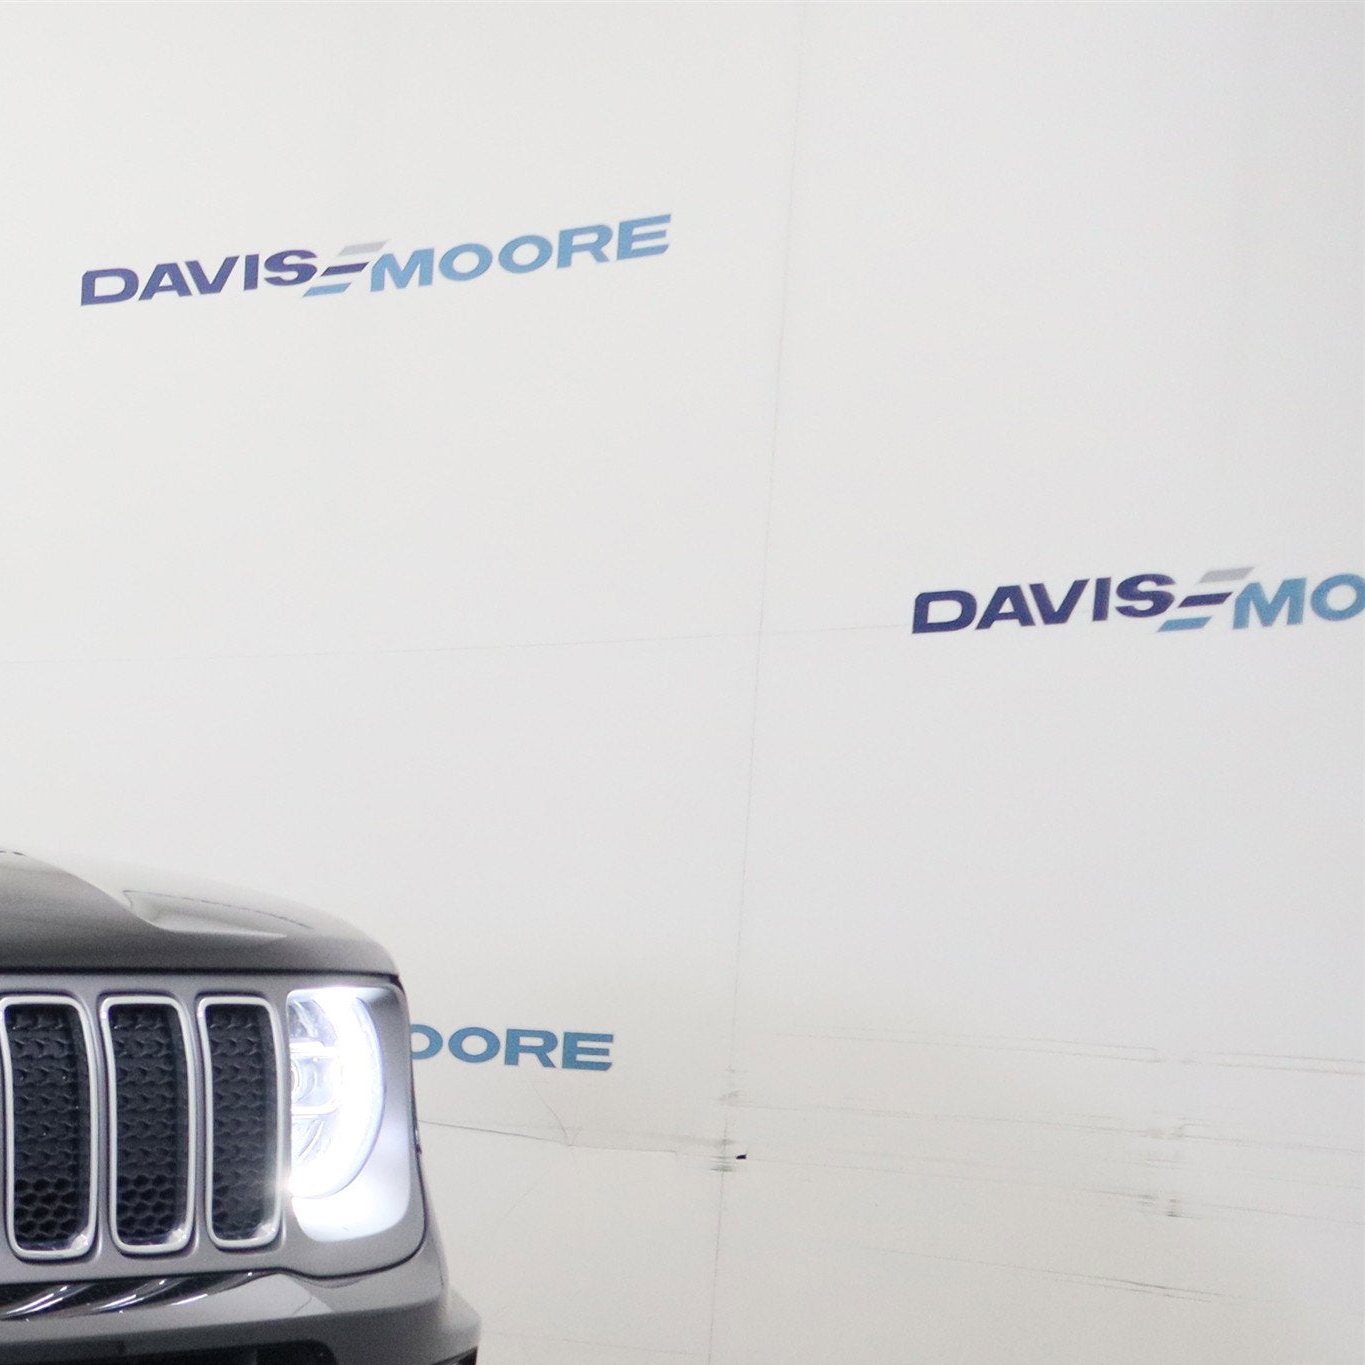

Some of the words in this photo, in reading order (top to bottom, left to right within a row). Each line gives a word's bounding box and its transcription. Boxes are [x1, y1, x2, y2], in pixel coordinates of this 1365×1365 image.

[81, 249, 318, 307] DAVIS
[370, 213, 672, 294] MOORE
[911, 573, 1176, 635] DAVIS
